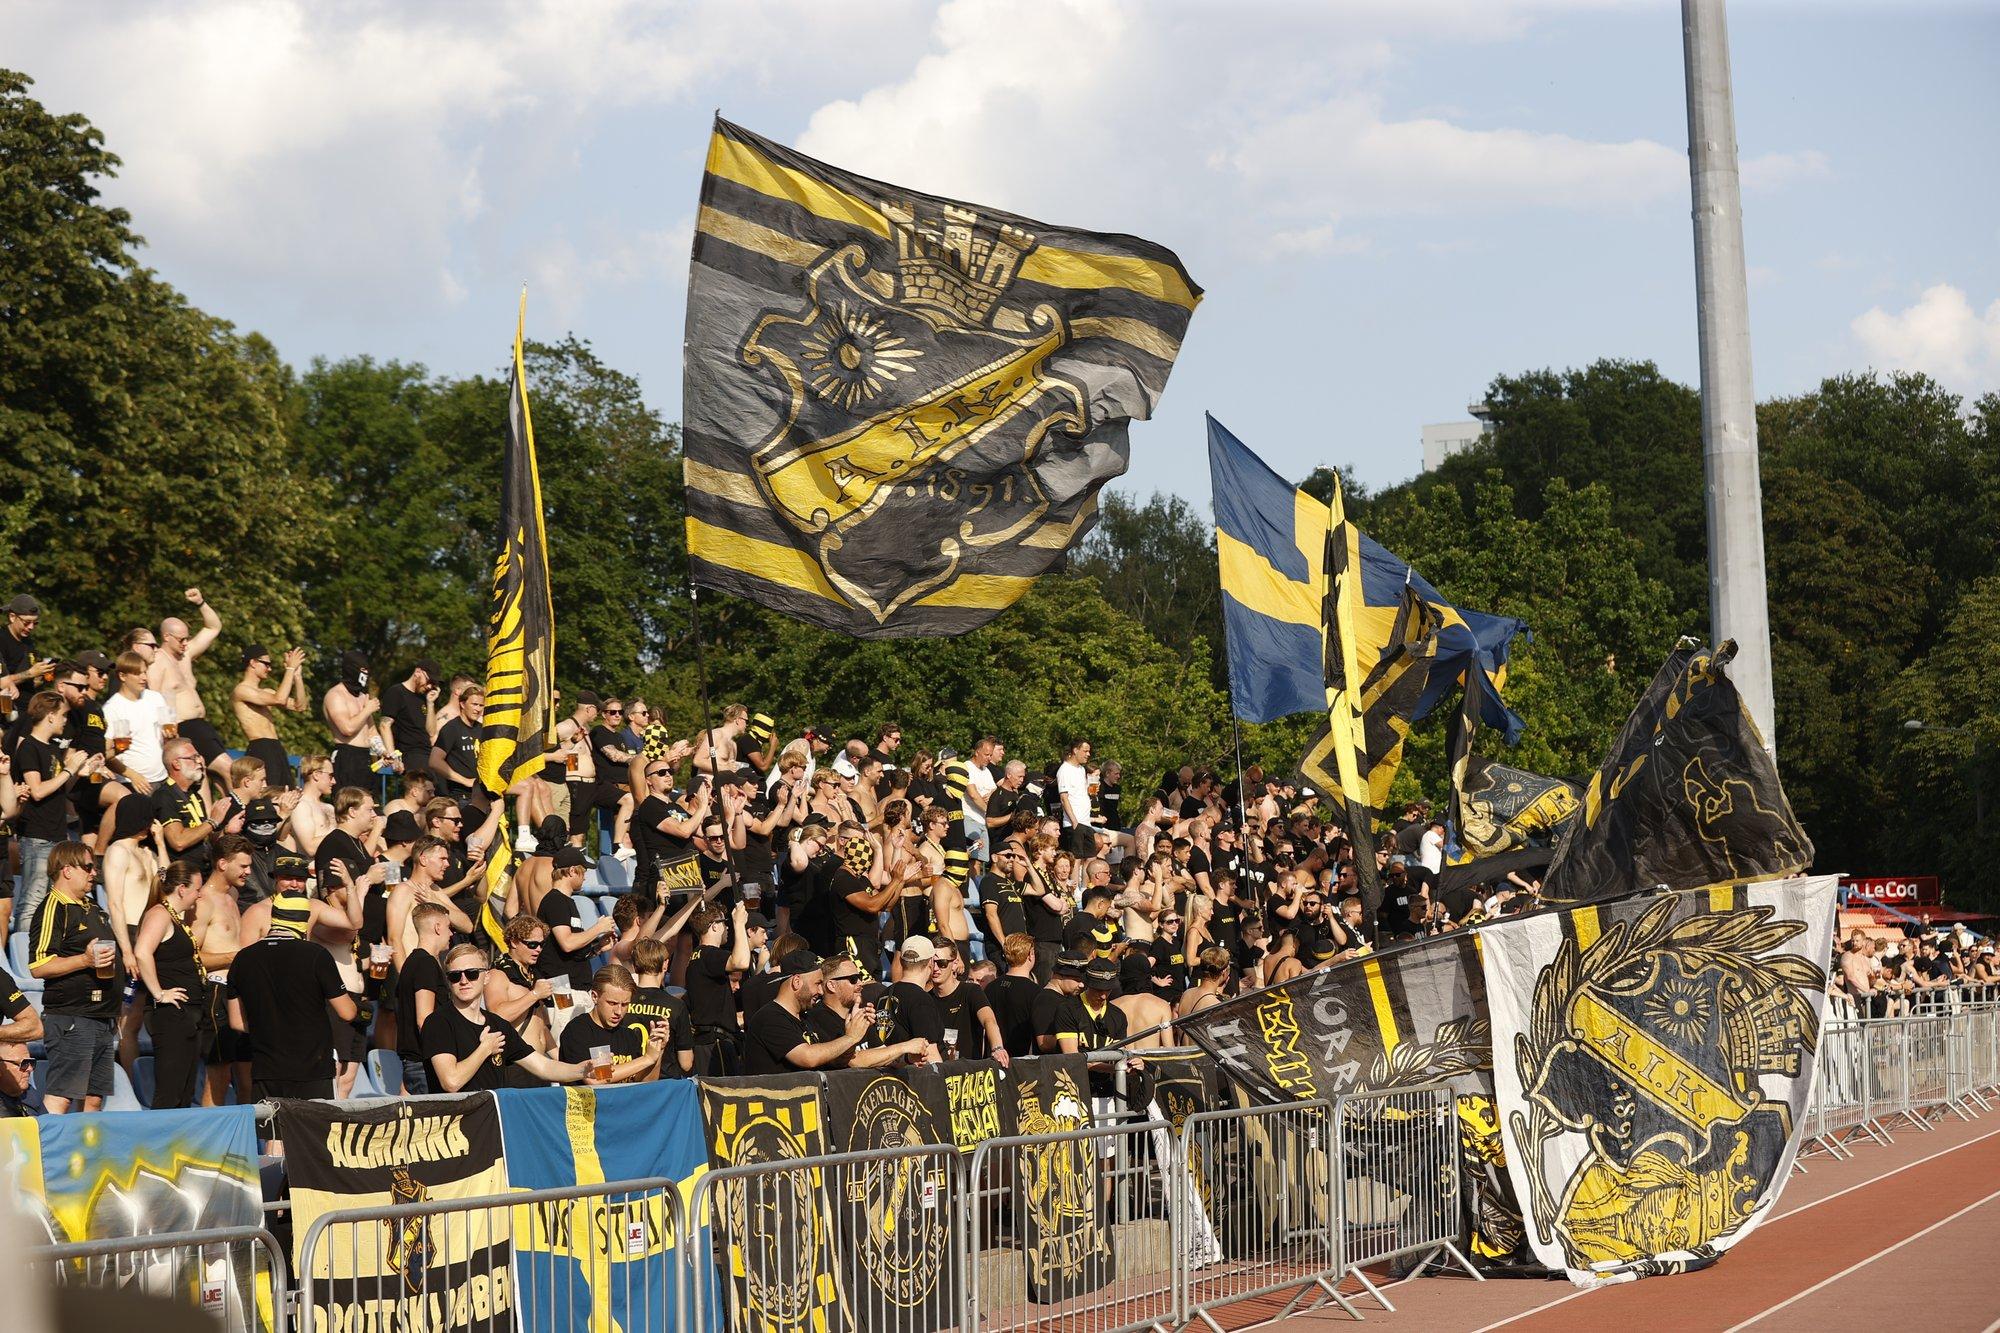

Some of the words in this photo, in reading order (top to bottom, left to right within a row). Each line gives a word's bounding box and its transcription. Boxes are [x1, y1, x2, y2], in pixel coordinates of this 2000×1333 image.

[628, 1003, 672, 1019] KOULLIS
[1308, 973, 1362, 1099] NORR
[326, 1105, 470, 1169] ALLMÄNNA
[859, 1085, 921, 1130] EKENLAGET
[296, 1264, 512, 1333] DROTTSKLUBBEN
